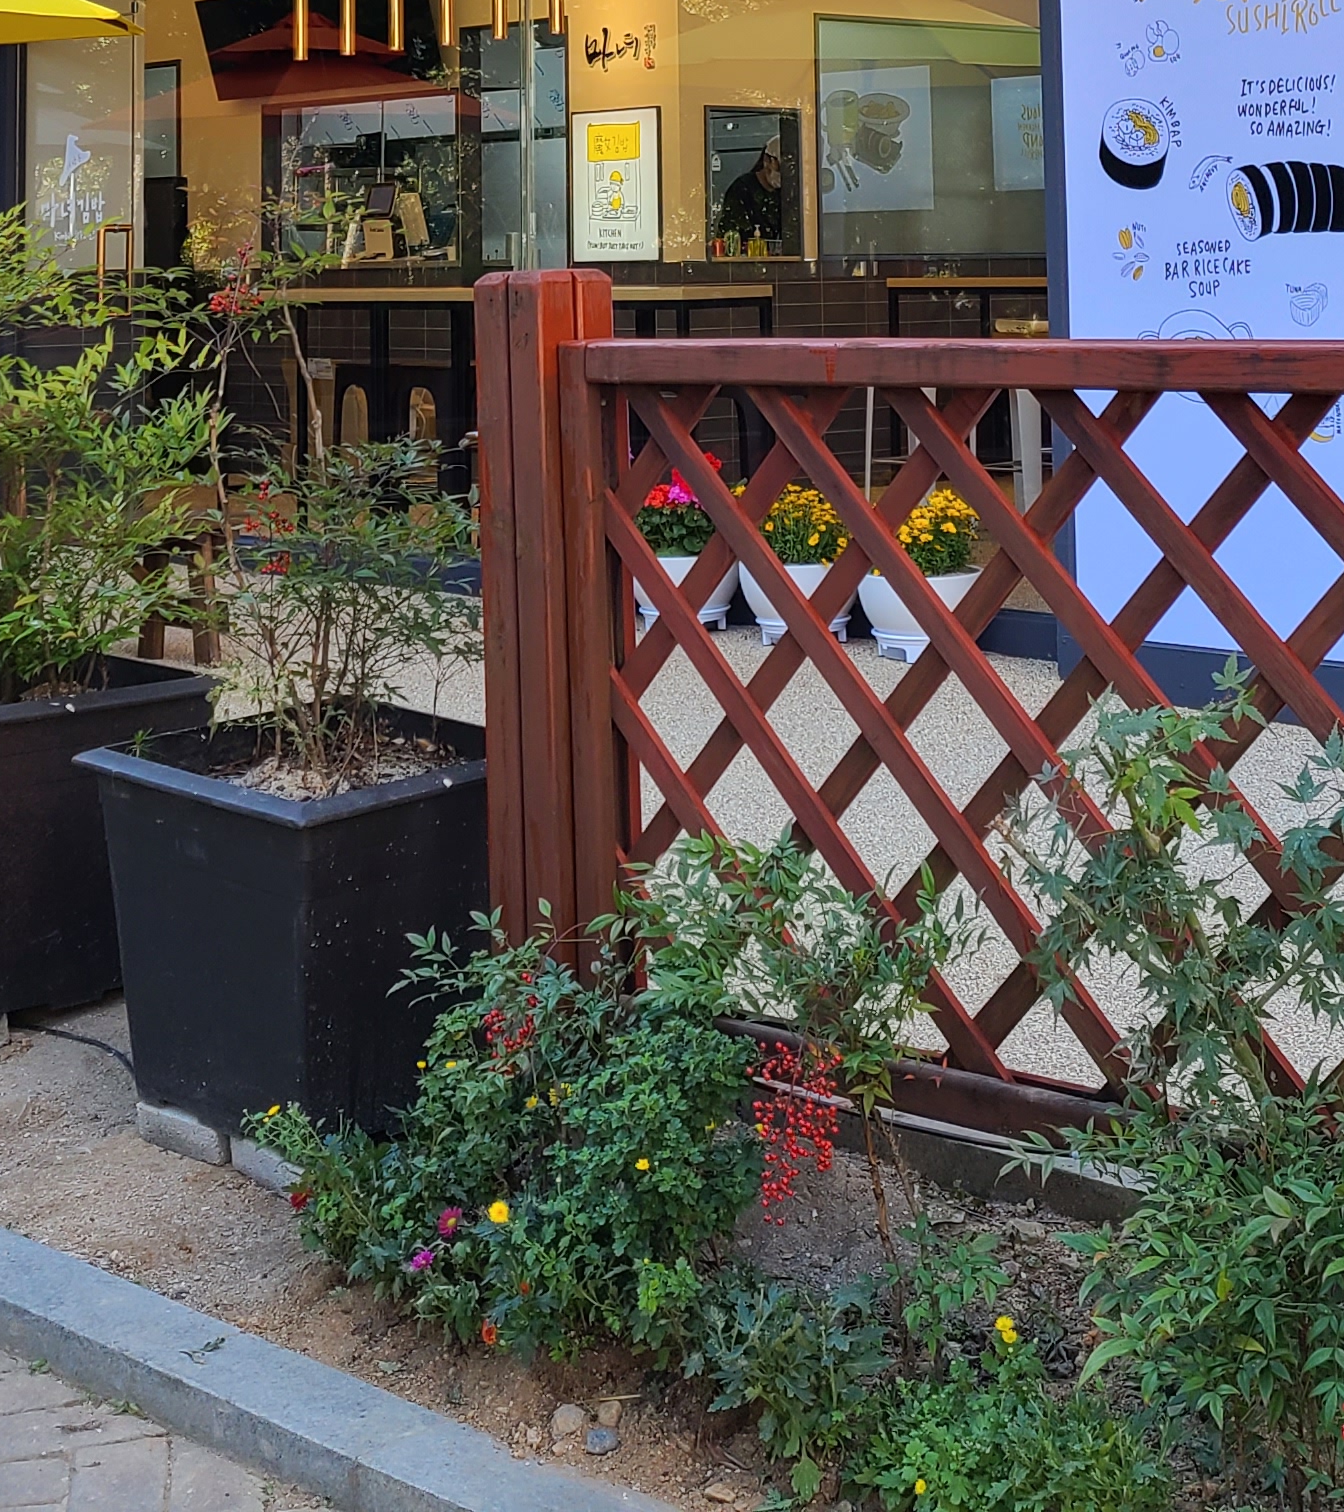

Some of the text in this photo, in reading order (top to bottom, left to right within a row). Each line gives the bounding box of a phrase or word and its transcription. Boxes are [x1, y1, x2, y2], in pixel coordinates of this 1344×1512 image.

[1237, 96, 1316, 118] WONDERFUL!
[1159, 95, 1182, 148] KIMBAP
[1250, 119, 1331, 138] SO AMAZING!
[1176, 239, 1231, 256] SEASONED
[1165, 257, 1251, 280] BAR RICE CAKE
[1189, 279, 1220, 298] SOUP
